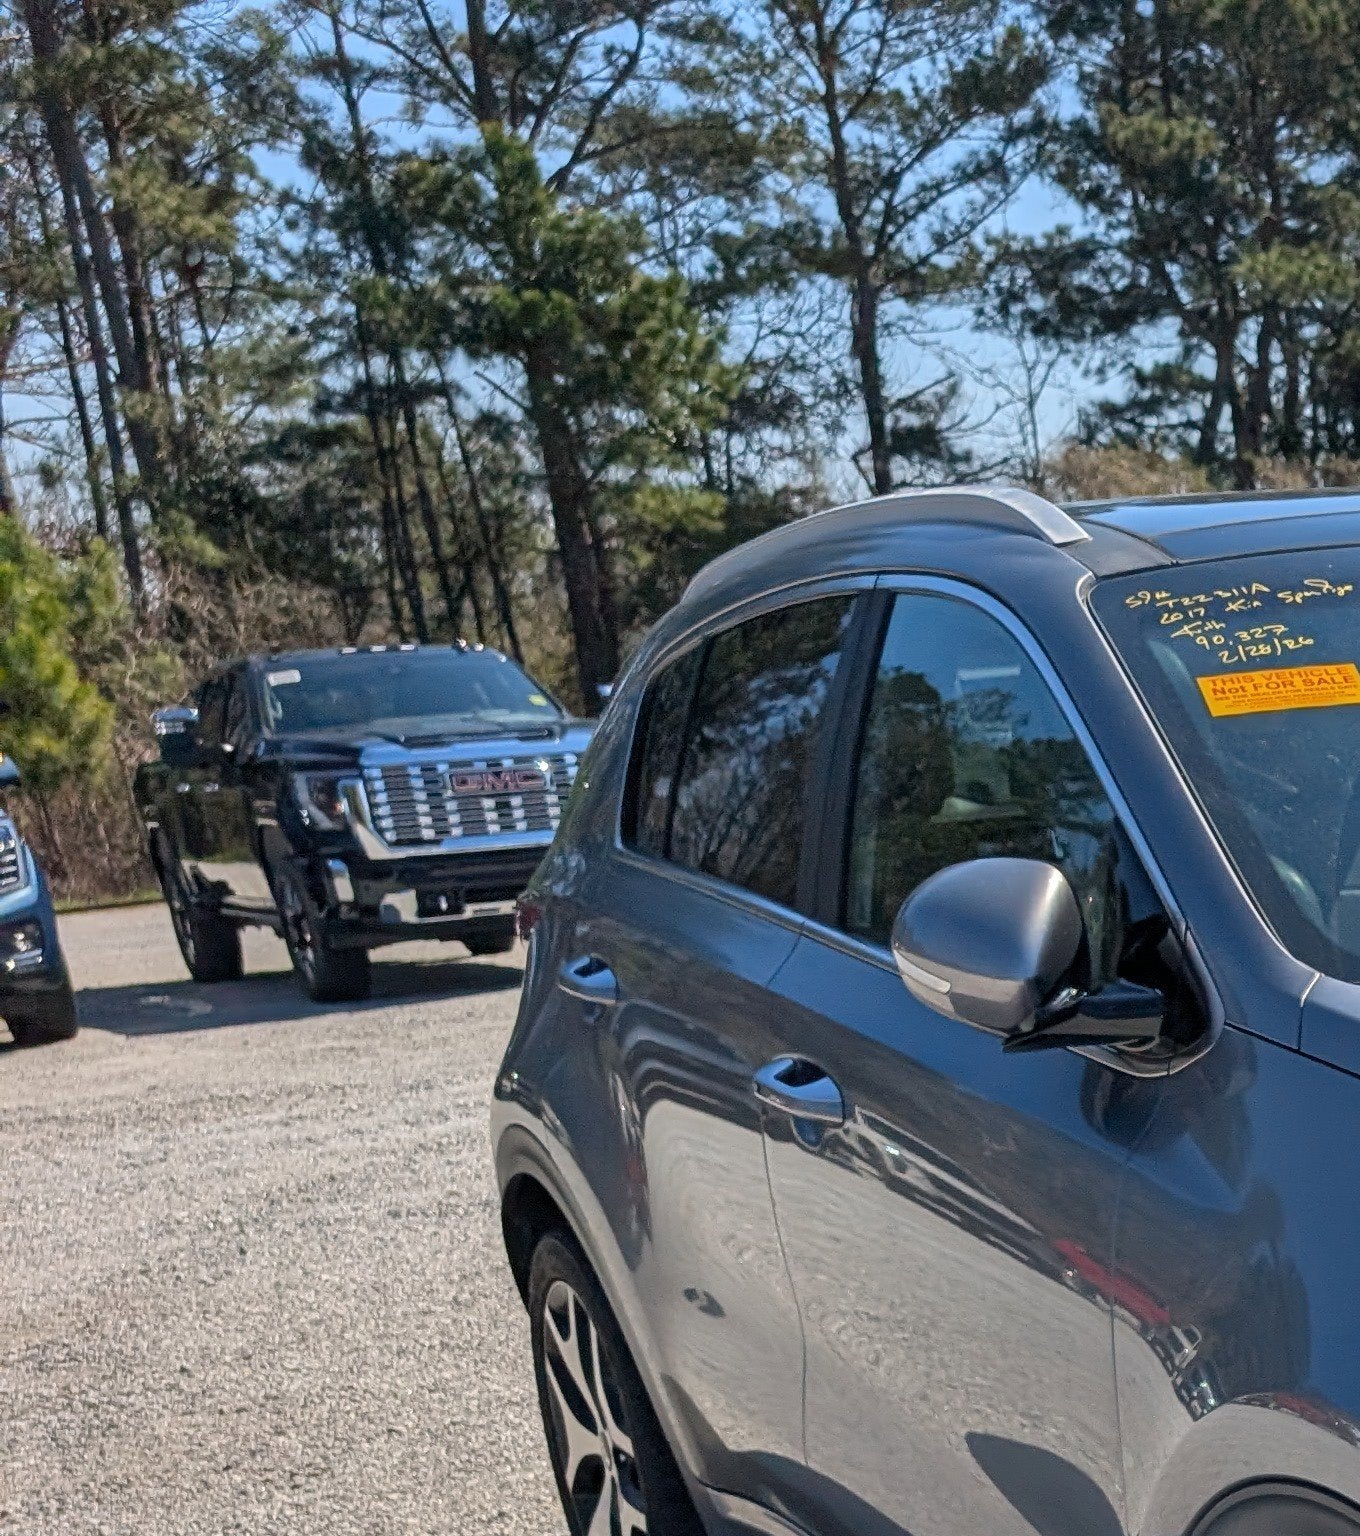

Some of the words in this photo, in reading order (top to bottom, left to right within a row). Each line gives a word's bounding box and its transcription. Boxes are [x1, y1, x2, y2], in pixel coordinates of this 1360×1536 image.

[1208, 674, 1255, 687] THIS
[1260, 666, 1351, 681] VEHICLE
[1252, 679, 1297, 693] FOR
[1302, 674, 1357, 687] SALE
[451, 769, 545, 791] GMC
